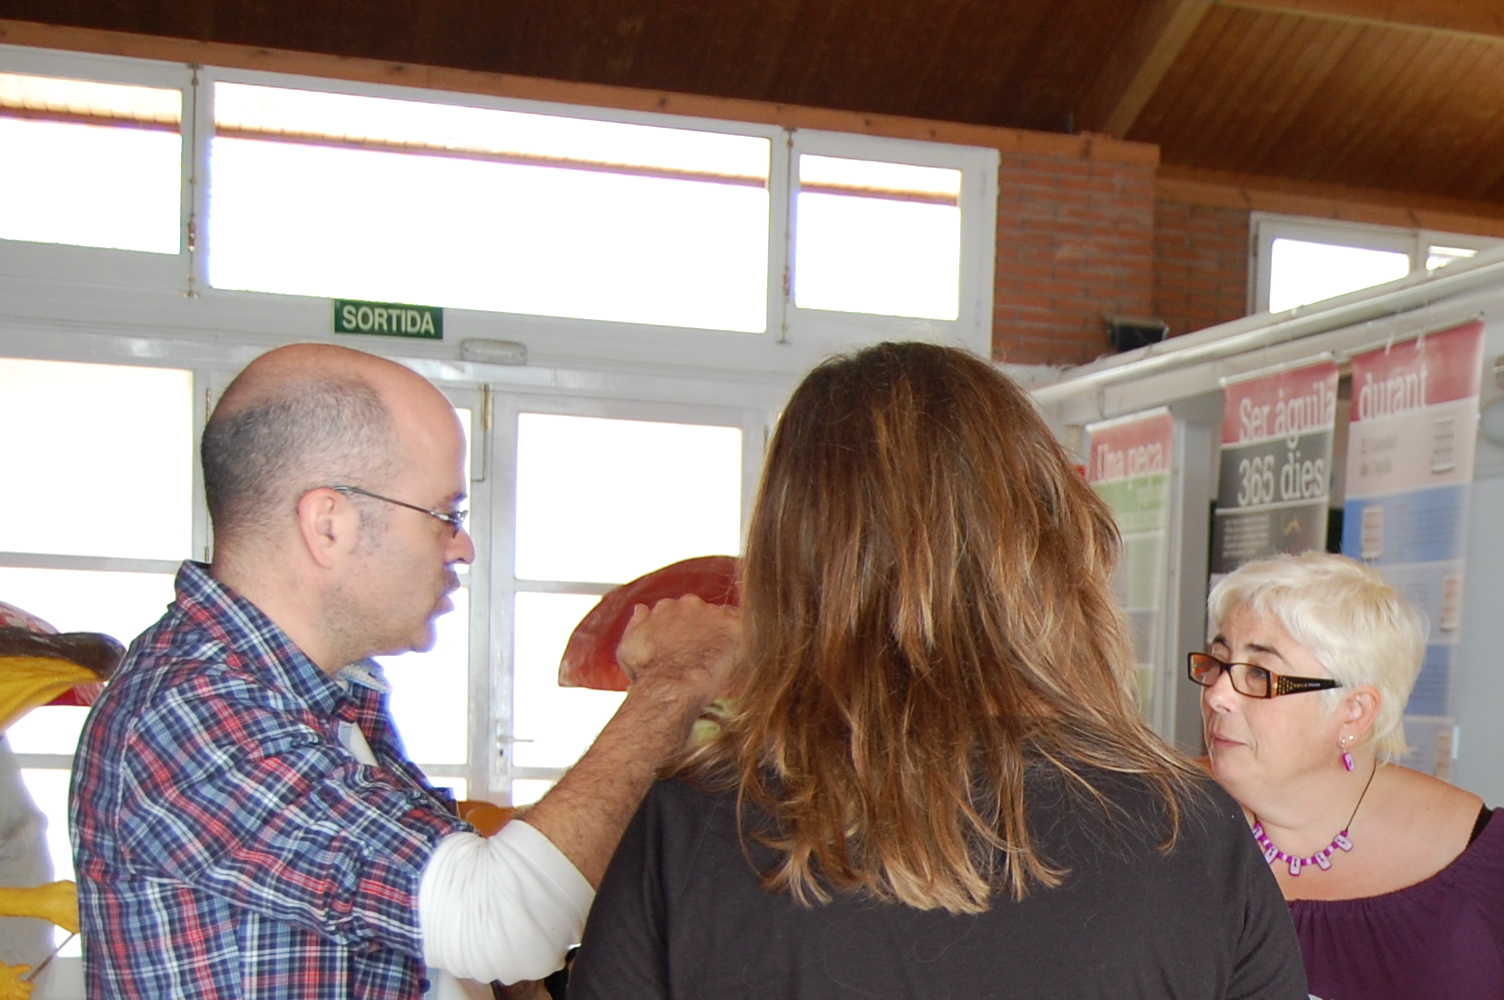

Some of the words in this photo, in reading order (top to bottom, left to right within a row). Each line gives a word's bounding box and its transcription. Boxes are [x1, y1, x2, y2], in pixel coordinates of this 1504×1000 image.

[342, 304, 435, 336] SORTIDA
[1239, 396, 1271, 443] Ser
[1275, 380, 1336, 450] àguila
[1357, 367, 1430, 422] durant
[1237, 454, 1275, 507] 365
[1280, 452, 1325, 500] dies
